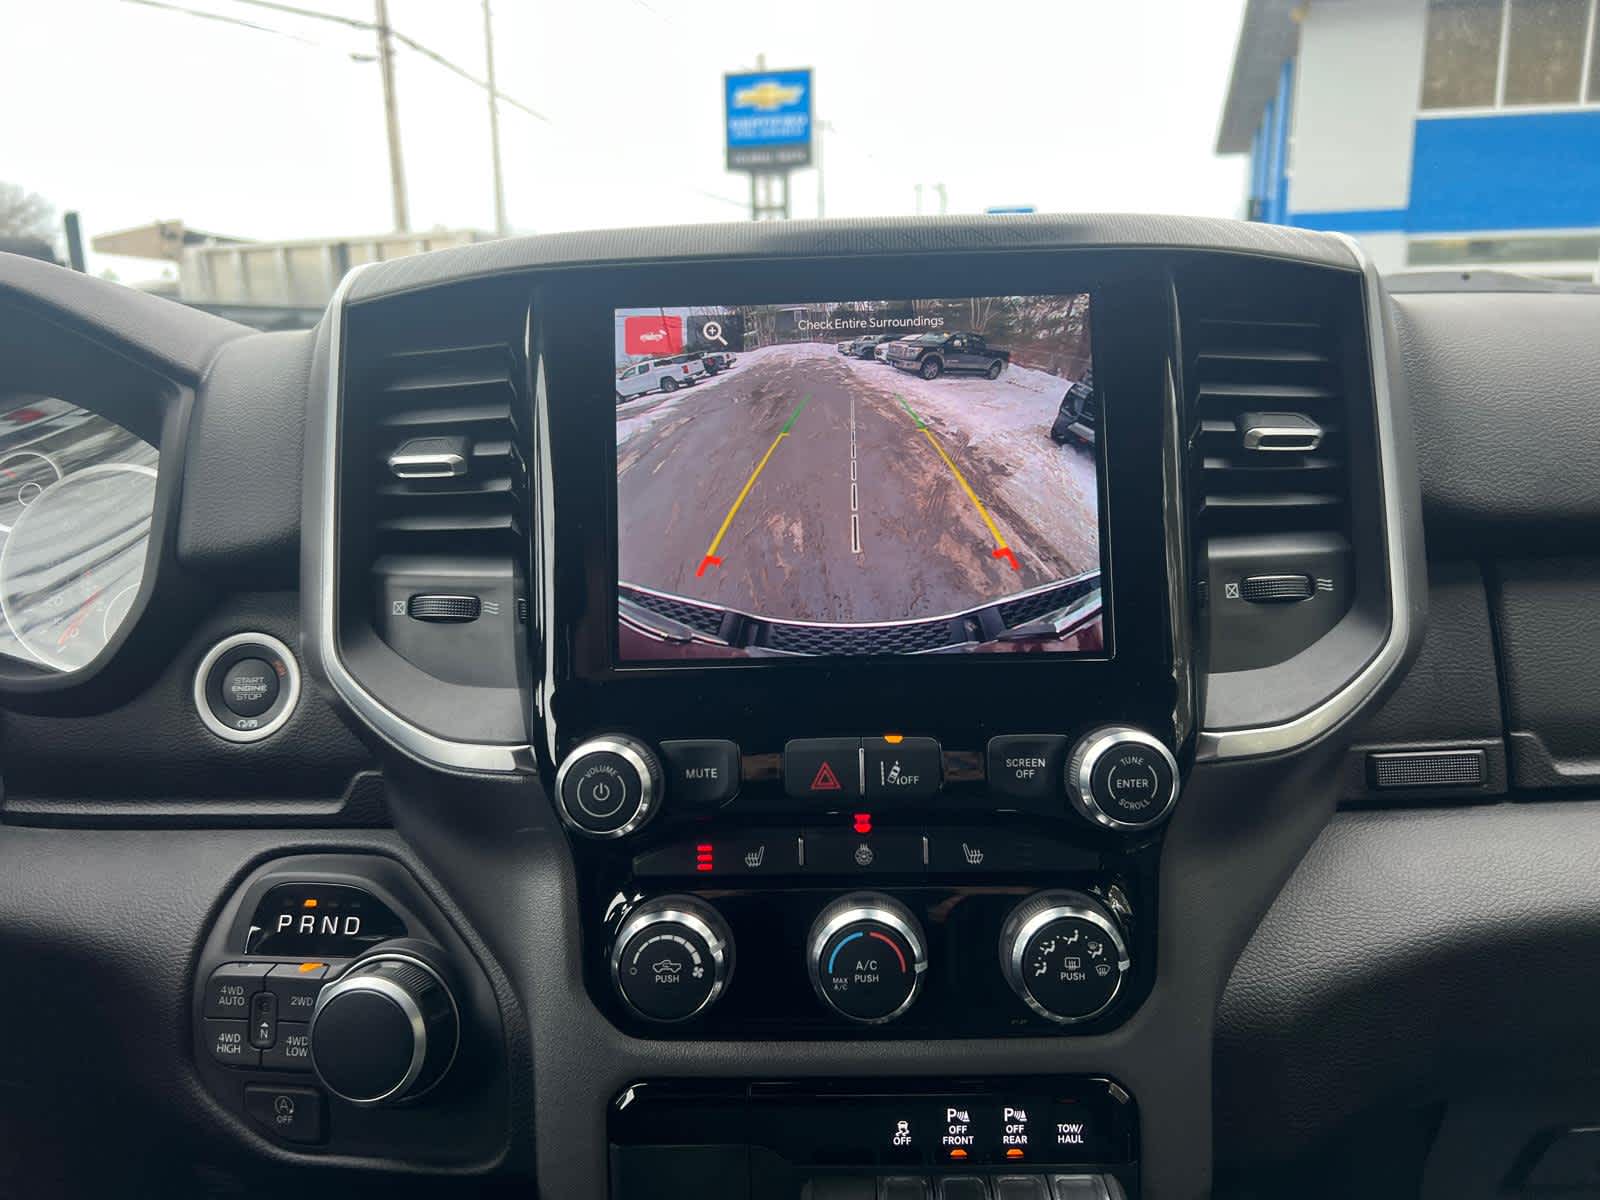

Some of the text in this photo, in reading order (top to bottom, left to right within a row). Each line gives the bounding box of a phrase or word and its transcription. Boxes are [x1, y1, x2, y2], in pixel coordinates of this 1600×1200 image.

[798, 316, 944, 330] Check Entire Surroundings
[1006, 758, 1045, 768] SCREEN
[1120, 756, 1144, 767] TUNE
[585, 766, 618, 779] VOLUME
[685, 768, 717, 779] MUTE
[1015, 768, 1035, 779] OFF
[900, 775, 918, 785] OFF
[1116, 778, 1148, 789] ENTER
[1118, 798, 1151, 809] SCROLL
[856, 960, 878, 971] A/C
[655, 974, 680, 984] PUSH
[854, 974, 879, 983] PUSH
[1060, 972, 1085, 981] PUSH
[220, 986, 243, 996] 4WD
[219, 996, 245, 1006] AUTO
[290, 996, 313, 1006] 2WD
[218, 1034, 241, 1043] 4WD
[286, 1036, 309, 1046] 4WD
[217, 1044, 241, 1054] HIGH
[286, 1046, 309, 1057] LOW
[277, 1115, 293, 1123] OFF
[949, 1125, 967, 1134] OFF
[1006, 1125, 1024, 1134] OFF
[1057, 1124, 1083, 1133] TOW/
[893, 1137, 911, 1146] OFF
[943, 1136, 974, 1145] FRONT
[1003, 1135, 1028, 1144] REAR
[1058, 1135, 1083, 1144] HAUL
